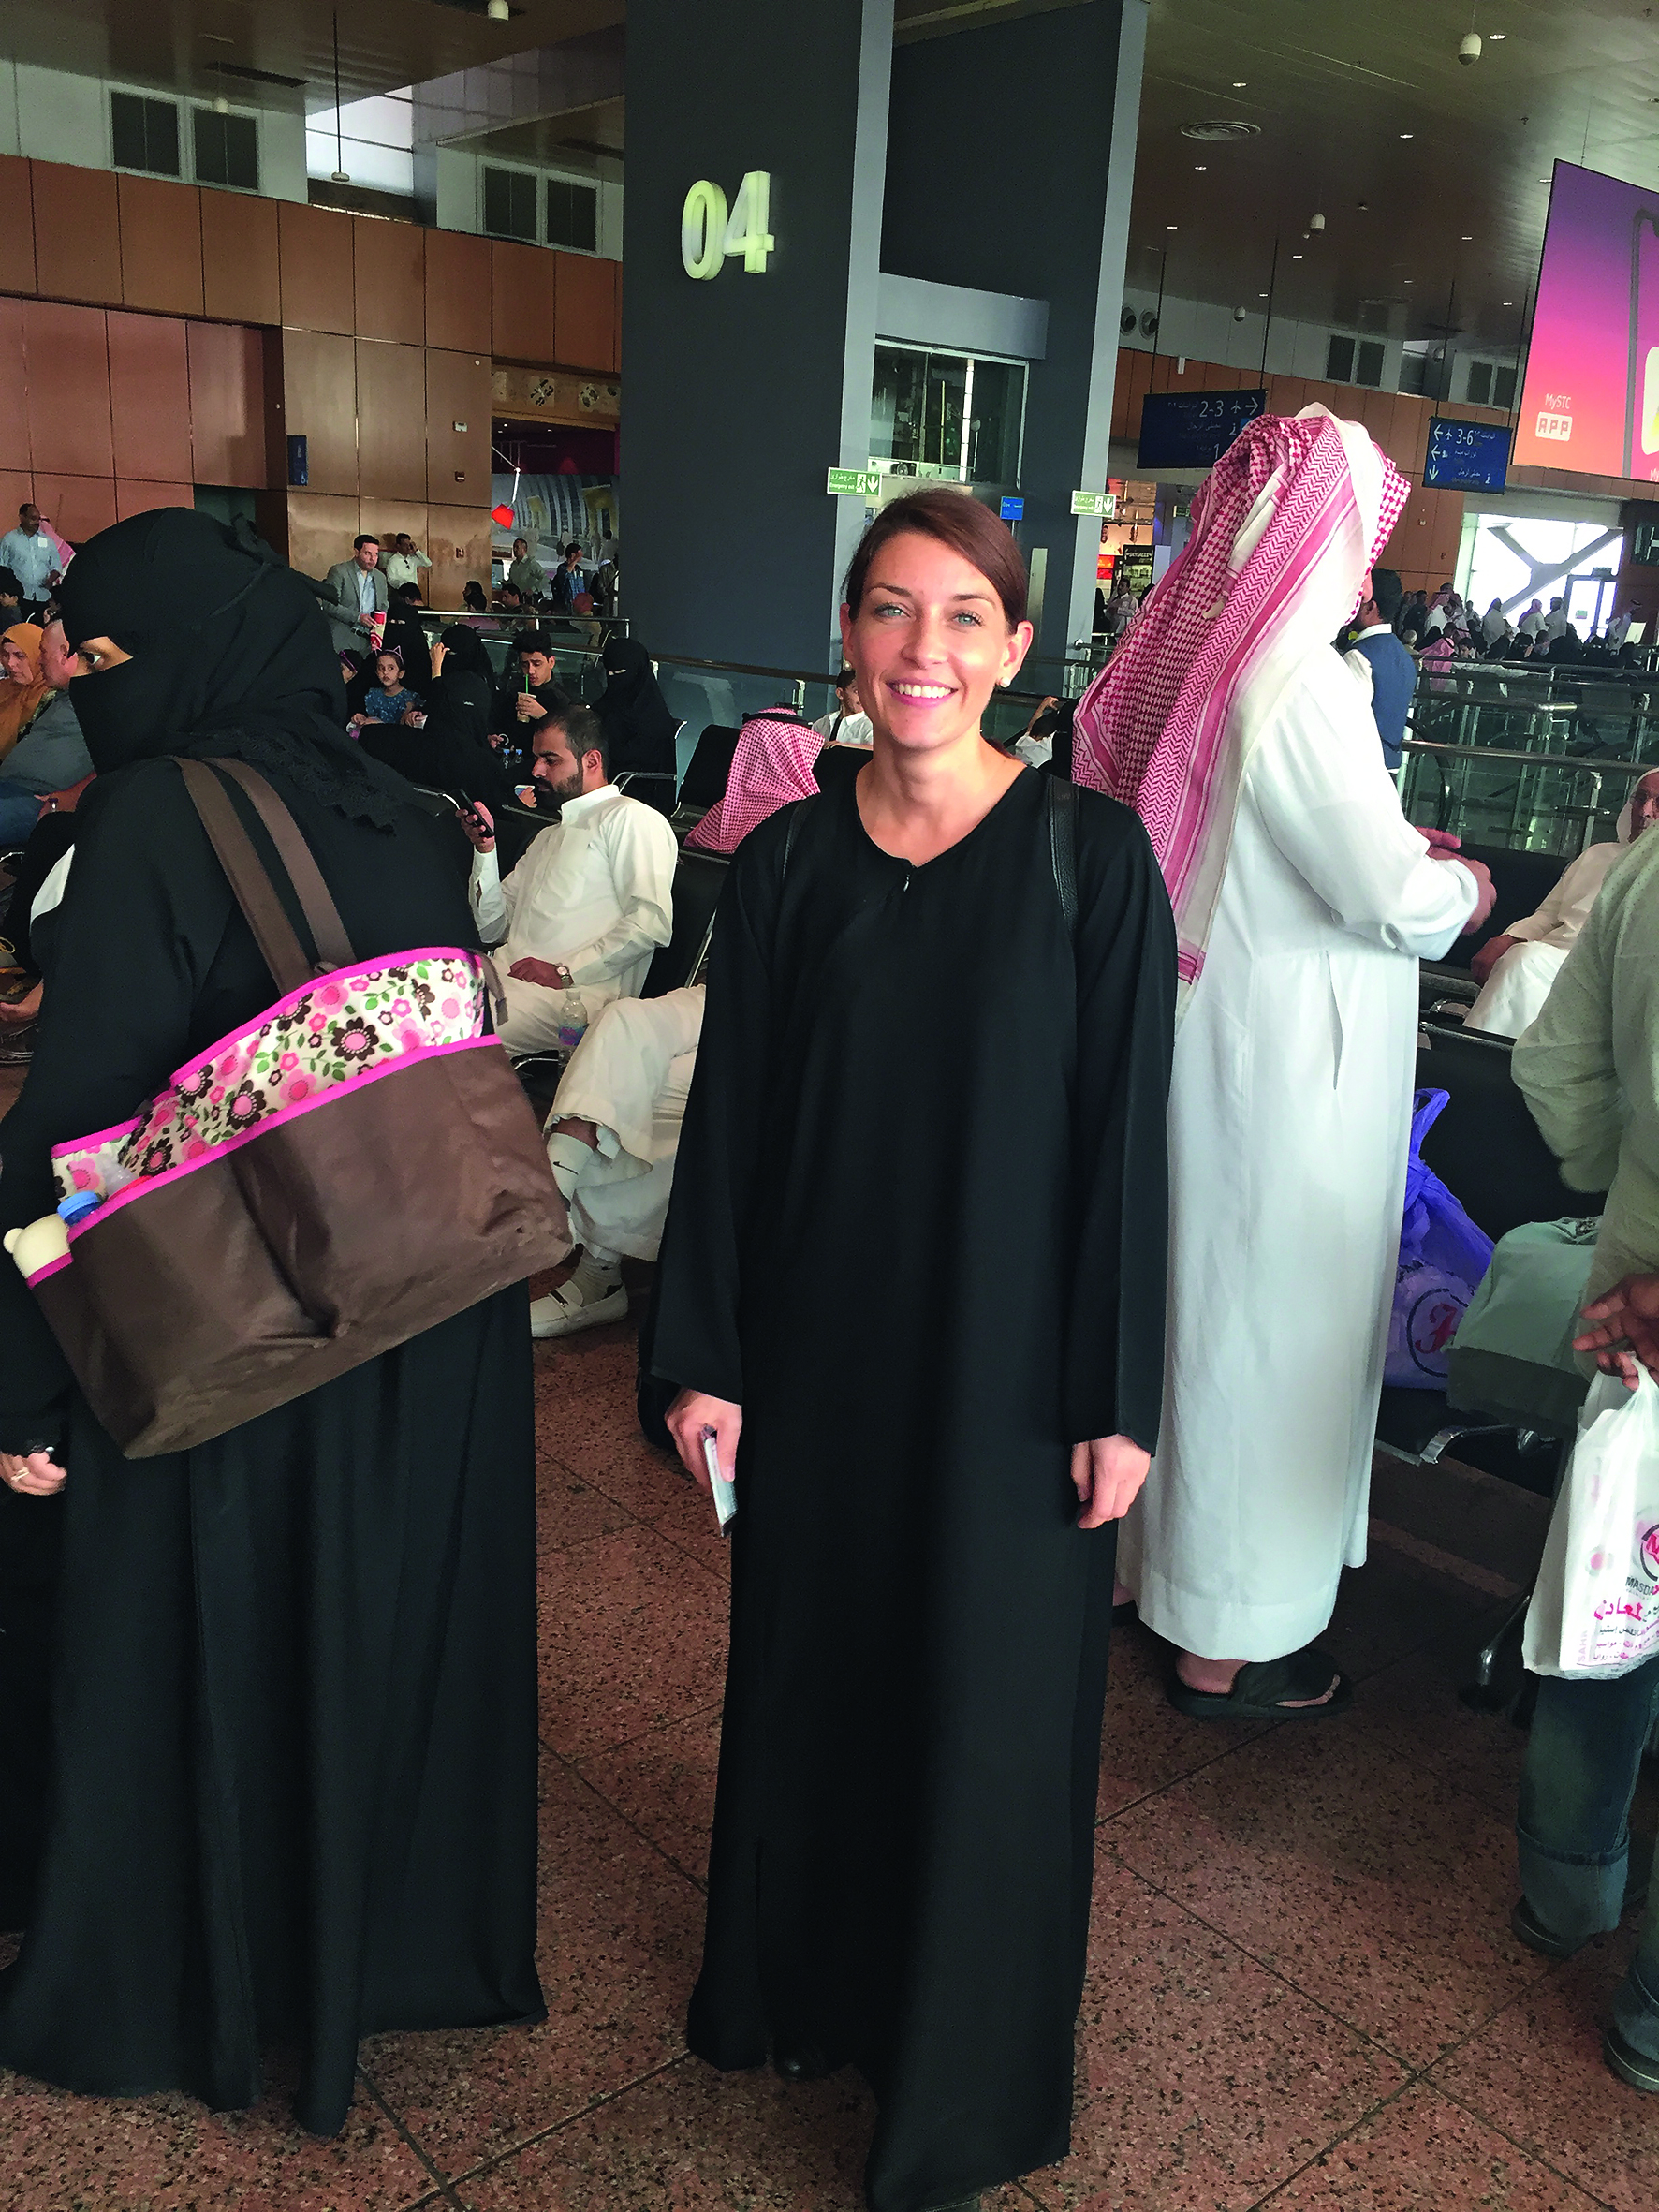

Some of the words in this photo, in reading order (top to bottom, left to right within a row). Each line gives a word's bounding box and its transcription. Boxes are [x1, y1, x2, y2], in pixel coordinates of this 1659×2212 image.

[682, 170, 775, 281] 04
[1199, 400, 1225, 418] 2-3
[1545, 393, 1572, 410] MySTC
[1538, 418, 1568, 435] APP
[1456, 428, 1474, 446] 3-6
[1213, 443, 1220, 460] 1
